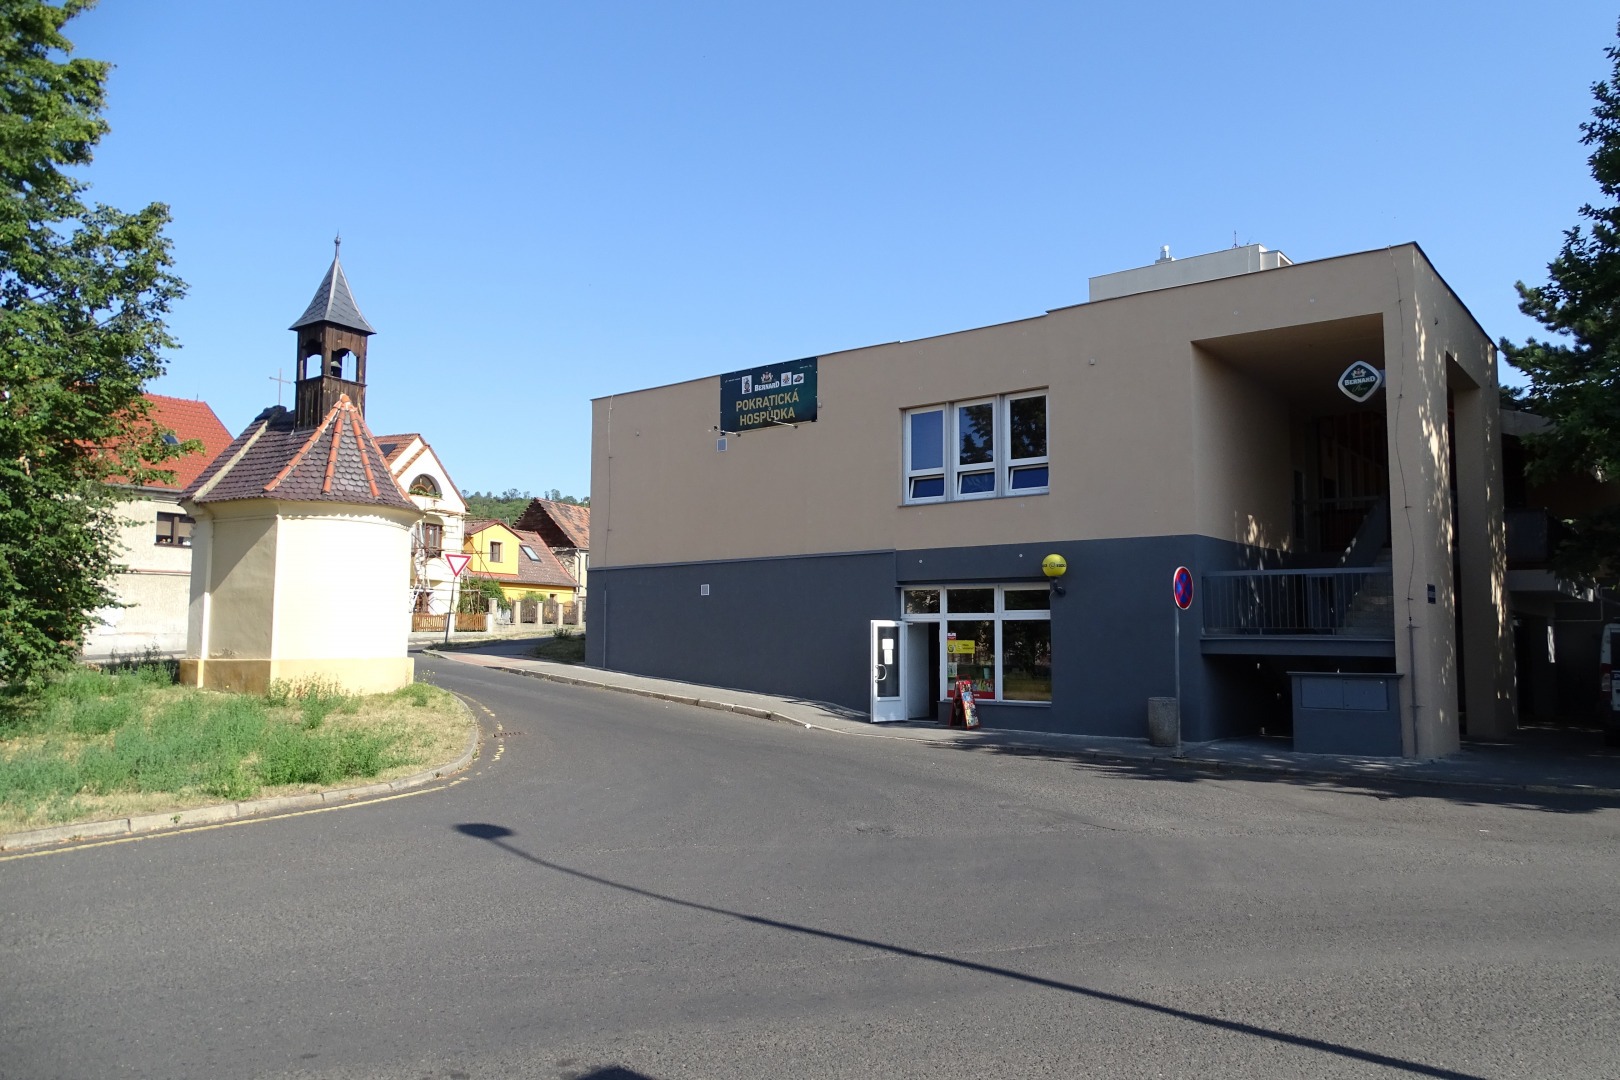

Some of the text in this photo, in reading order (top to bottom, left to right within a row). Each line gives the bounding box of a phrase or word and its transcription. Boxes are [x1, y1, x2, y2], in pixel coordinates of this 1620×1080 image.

[754, 381, 780, 392] BERNARD
[1344, 375, 1376, 386] BERNARD
[735, 388, 800, 412] POKRATICKÁ
[739, 407, 796, 426] HOSPŮDKA
